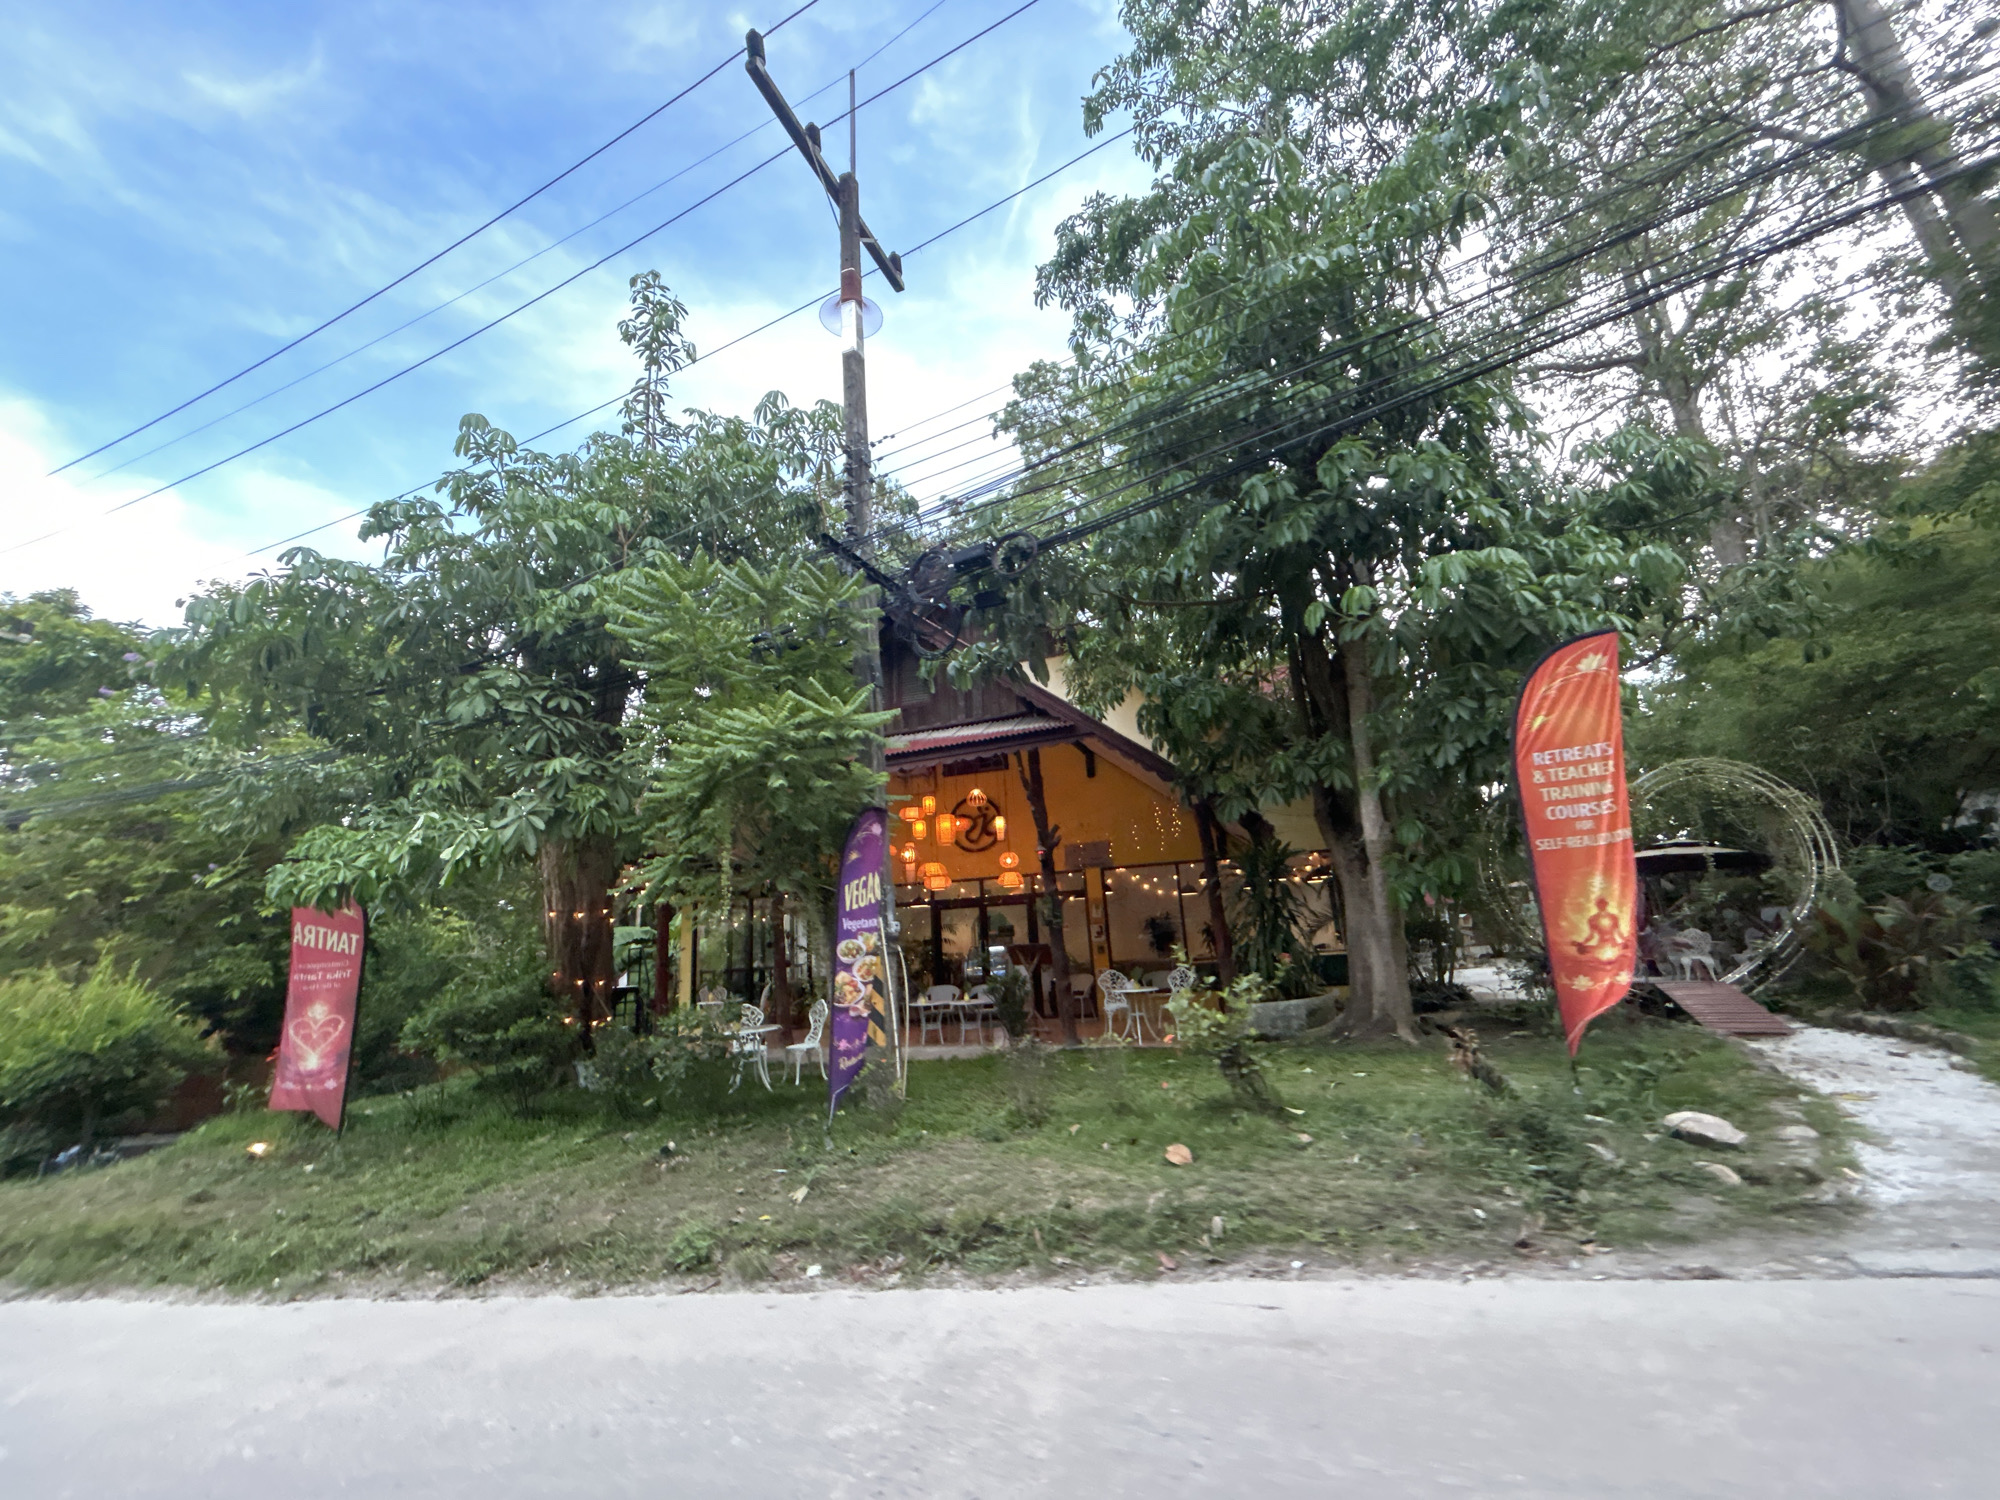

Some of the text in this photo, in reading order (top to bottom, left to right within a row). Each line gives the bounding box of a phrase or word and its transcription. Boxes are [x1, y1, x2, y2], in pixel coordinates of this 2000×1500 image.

[1532, 742, 1614, 766] RETREATS
[1532, 770, 1546, 784] &
[1539, 780, 1614, 802] TRAINING
[1545, 798, 1617, 820] COURSES
